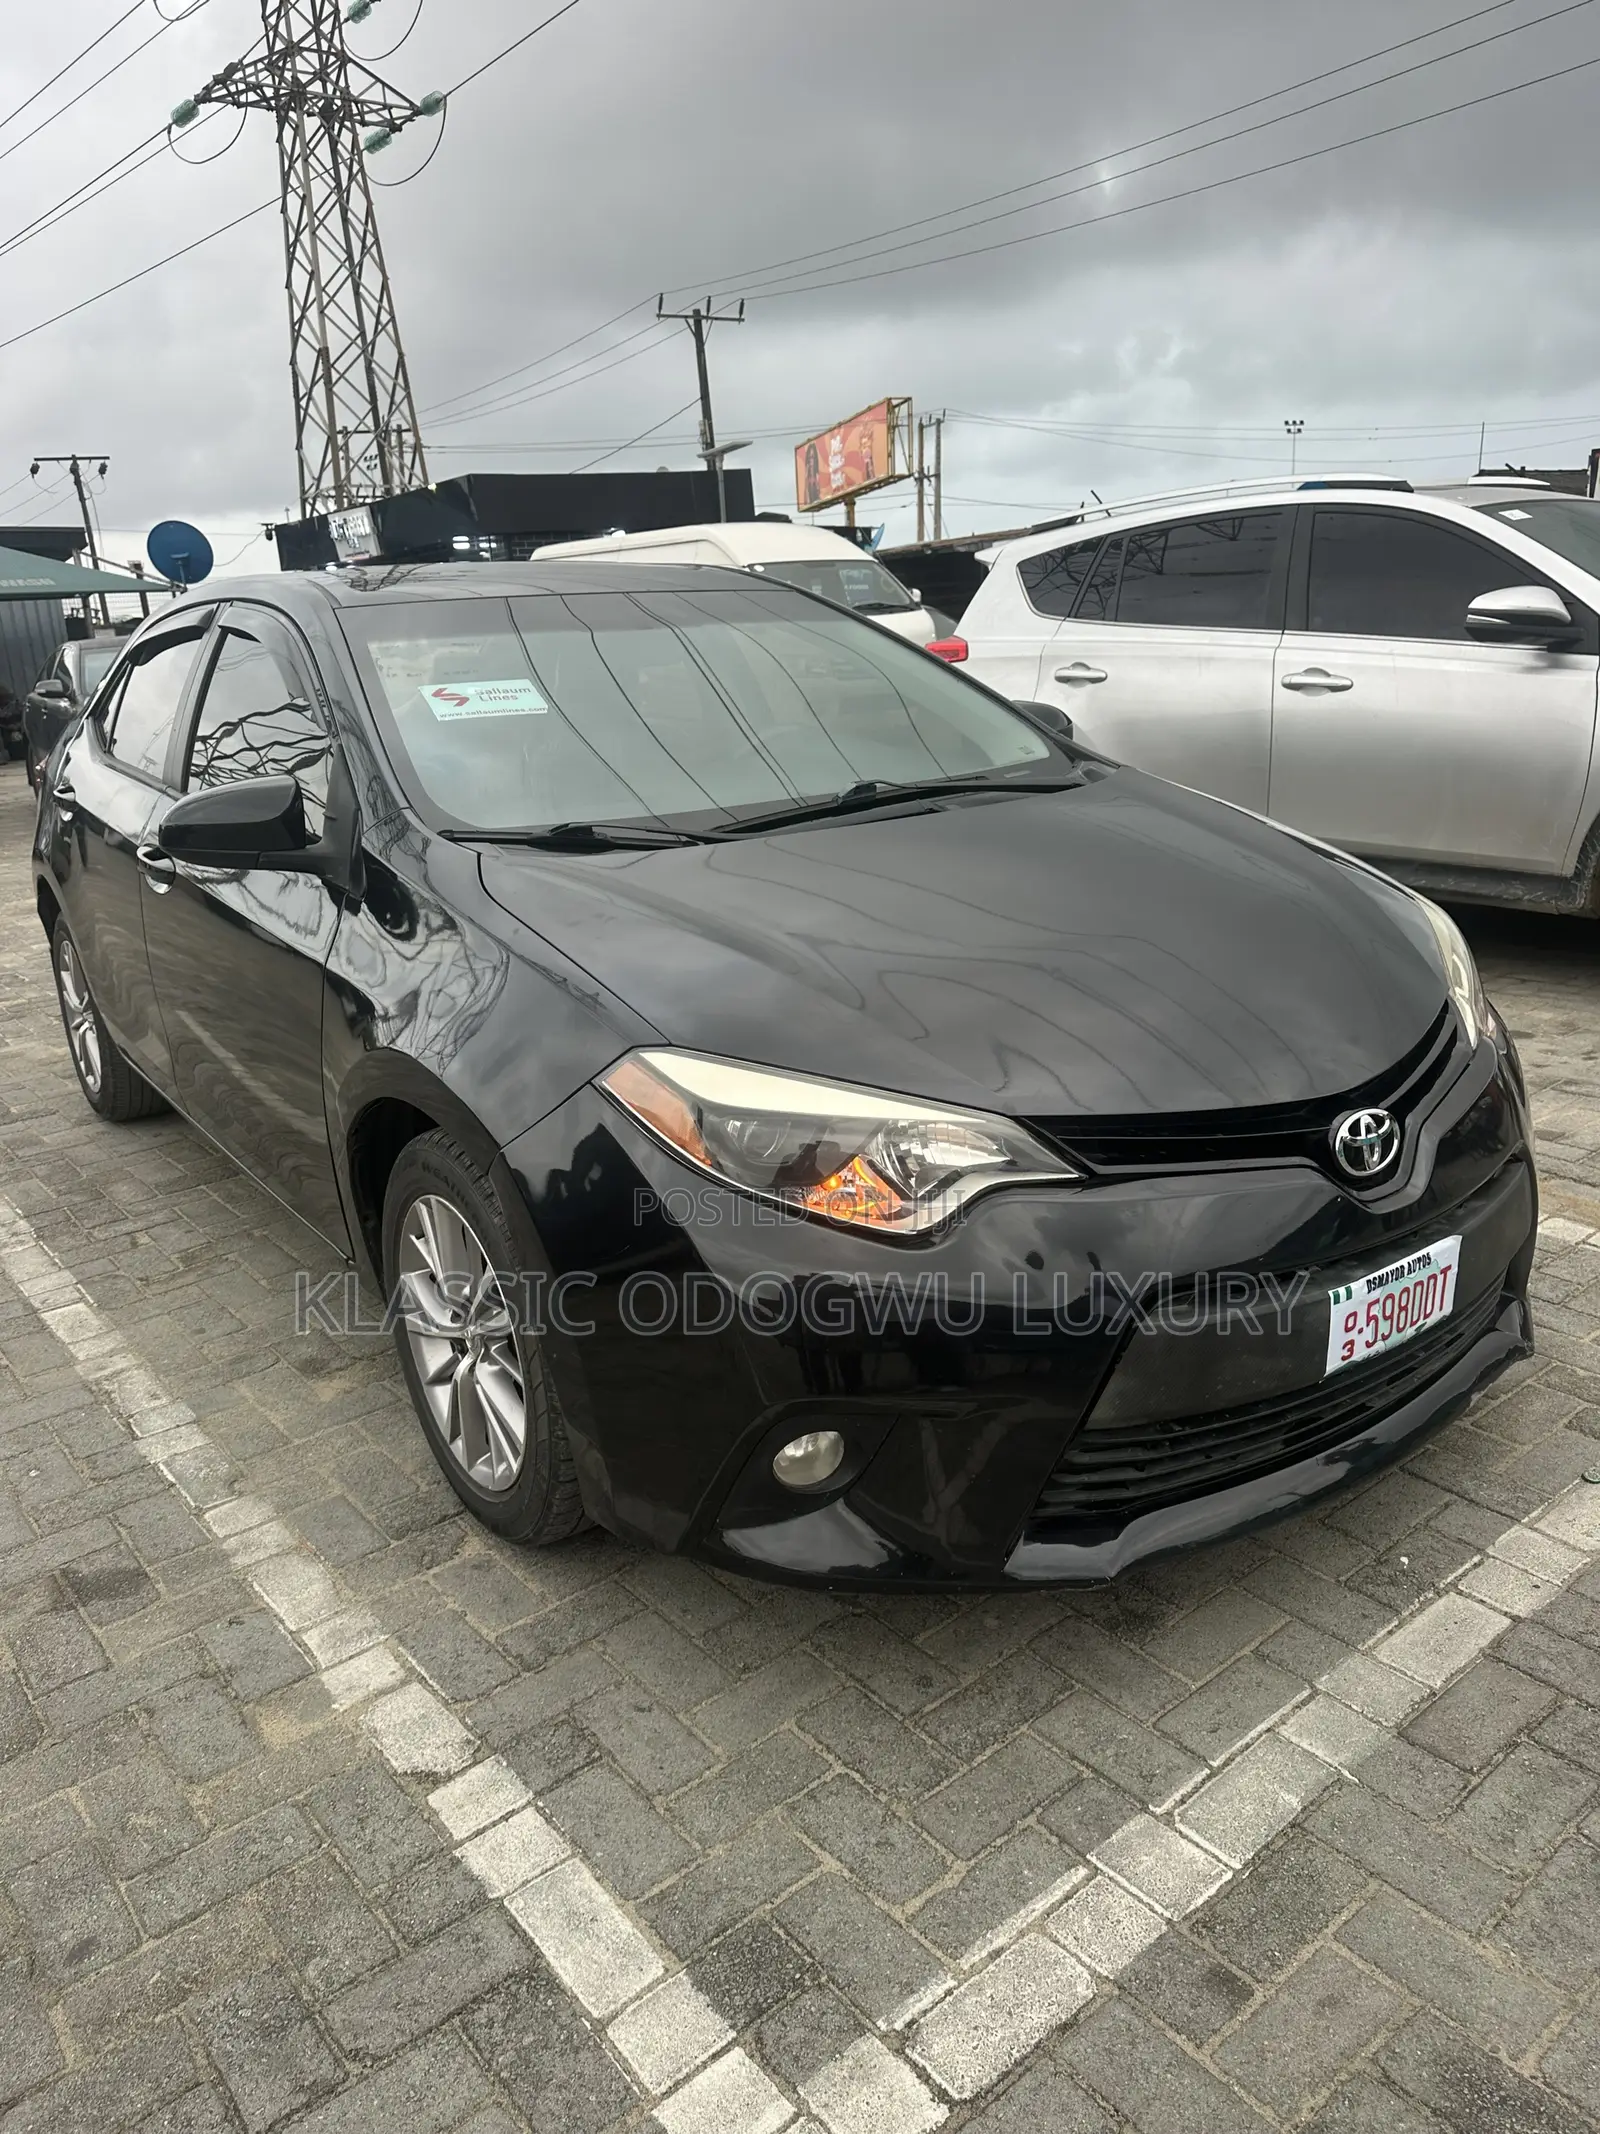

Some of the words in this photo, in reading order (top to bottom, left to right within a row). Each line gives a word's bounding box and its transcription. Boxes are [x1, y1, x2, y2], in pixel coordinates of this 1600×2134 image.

[478, 694, 519, 702] Lines
[1366, 1265, 1406, 1295] DSMAYOR
[1406, 1251, 1432, 1277] AUTOS
